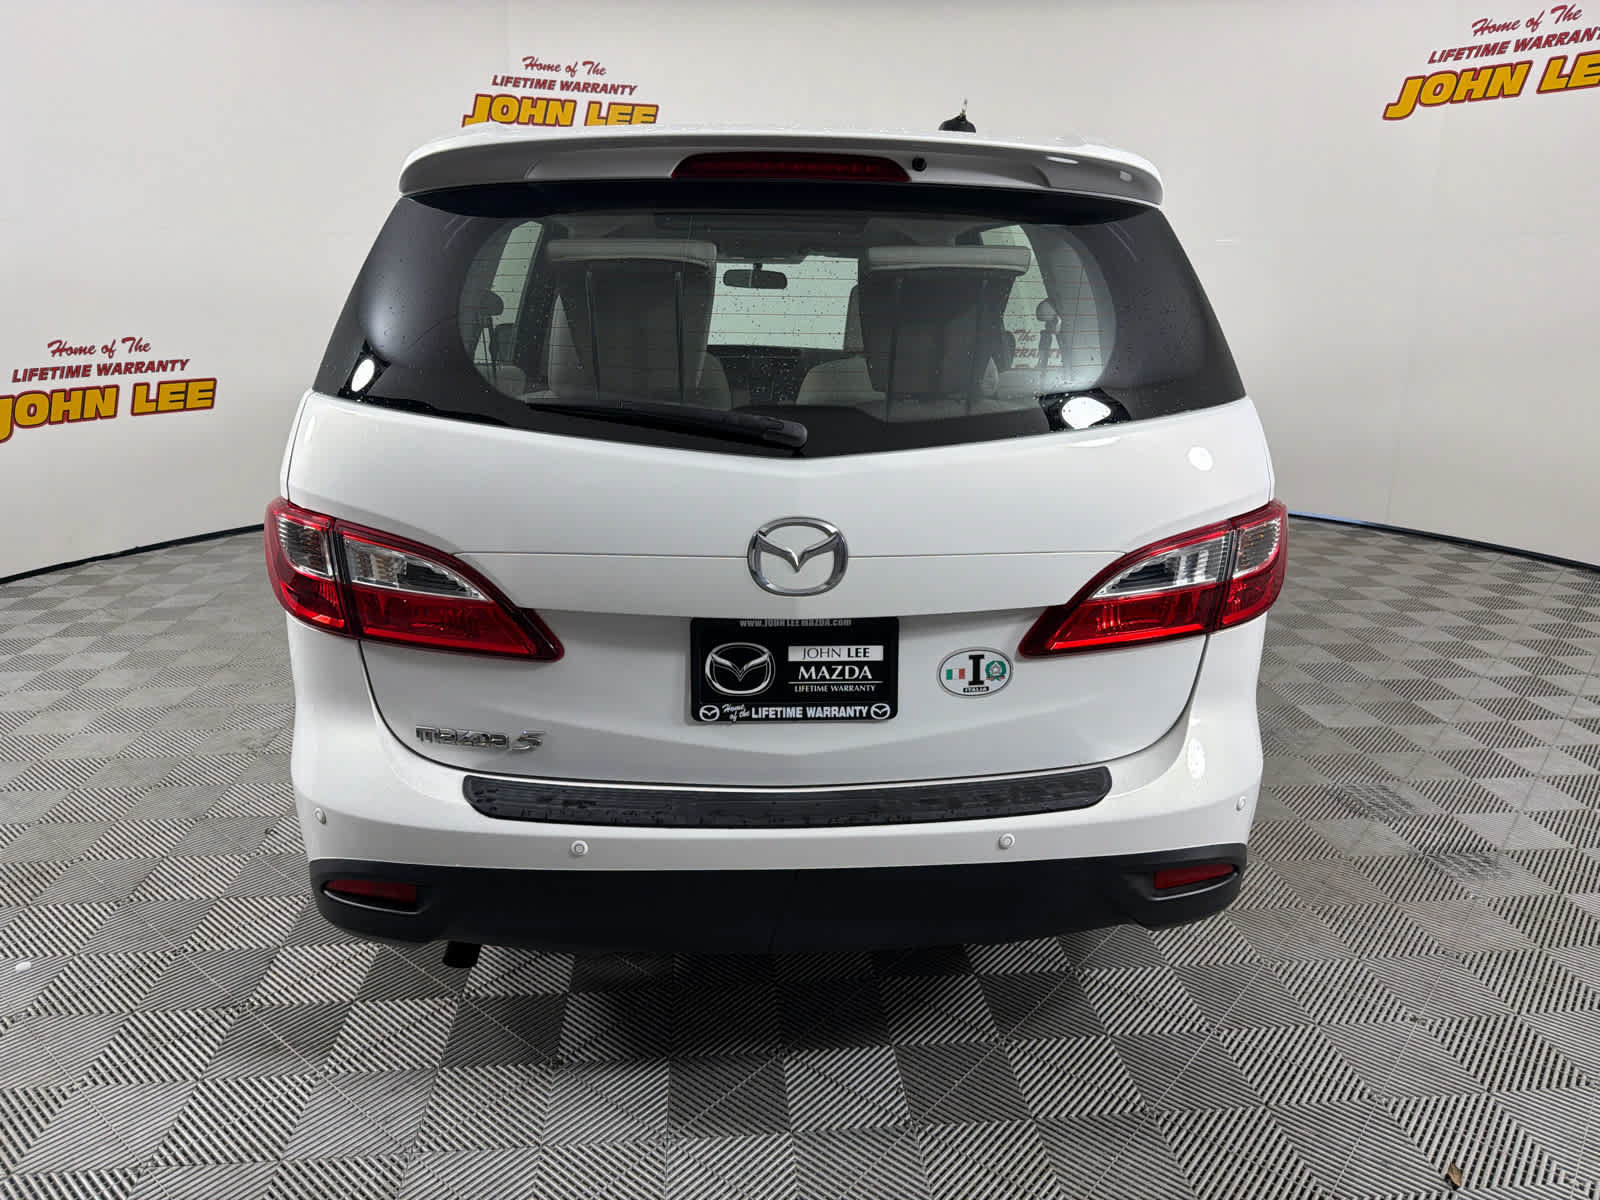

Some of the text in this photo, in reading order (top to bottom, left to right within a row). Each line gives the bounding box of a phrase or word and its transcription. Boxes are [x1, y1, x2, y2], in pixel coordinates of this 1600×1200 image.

[1472, 4, 1583, 37] Home of The
[1428, 40, 1511, 64] LIFETIME
[522, 56, 607, 77] Home of The
[492, 75, 637, 96] LIFETIME WARRANTY
[1382, 60, 1533, 120] JOHN
[462, 94, 659, 128] JOHN LEE
[47, 337, 151, 358] Home of The
[12, 359, 190, 383] LIFETIME WARRANTY
[130, 378, 217, 416] LEE
[802, 647, 870, 660] JOHN LEE
[798, 665, 873, 680] MAZDA
[968, 654, 985, 686] I
[794, 684, 876, 693] LIFETIME WARRANTY
[722, 703, 745, 713] Home
[752, 705, 869, 719] LIFETIME WARRANTY
